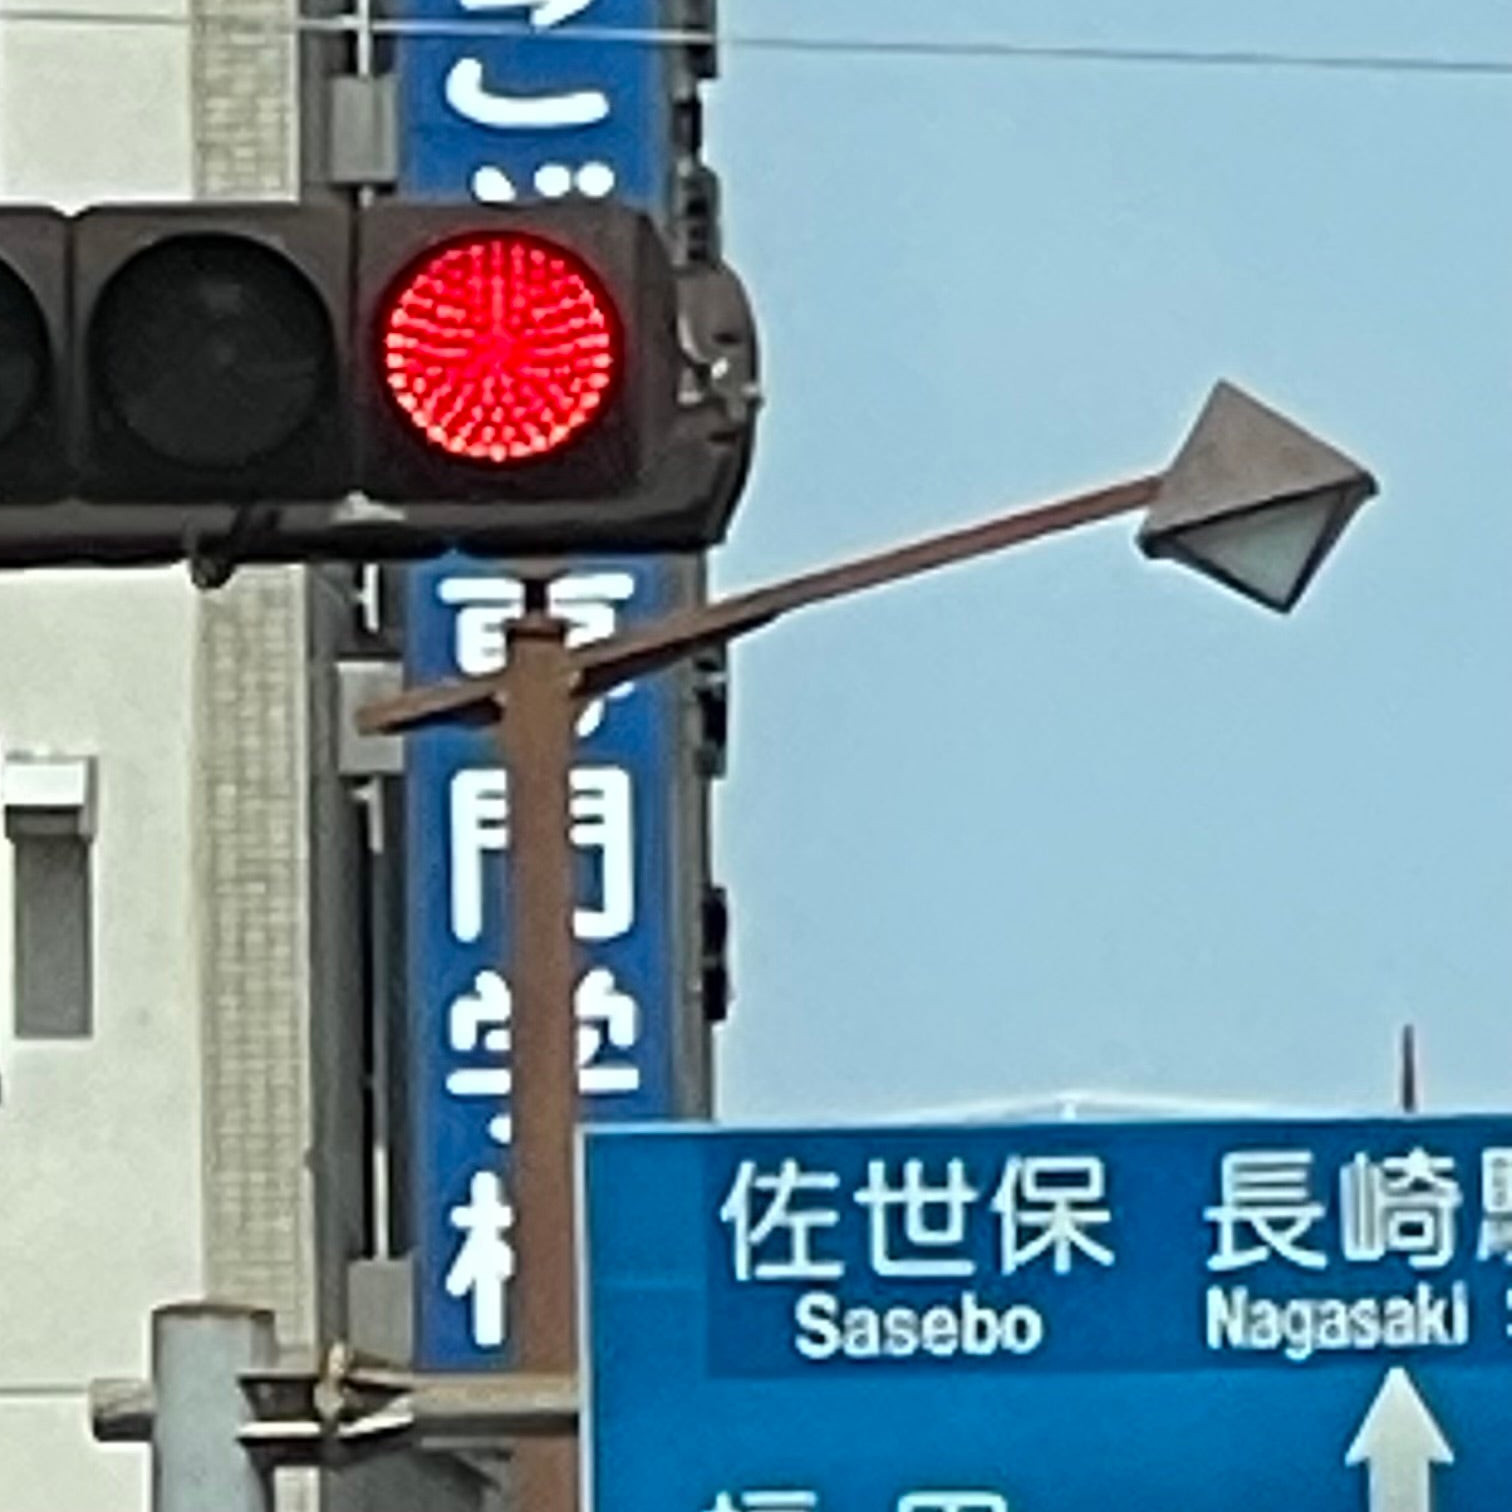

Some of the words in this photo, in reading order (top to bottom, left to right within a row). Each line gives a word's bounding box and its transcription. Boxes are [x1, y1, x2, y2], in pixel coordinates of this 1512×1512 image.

[718, 1154, 1116, 1282] 佐世保
[794, 1291, 1044, 1360] Sasebo
[1205, 1280, 1470, 1361] Nagasaki
